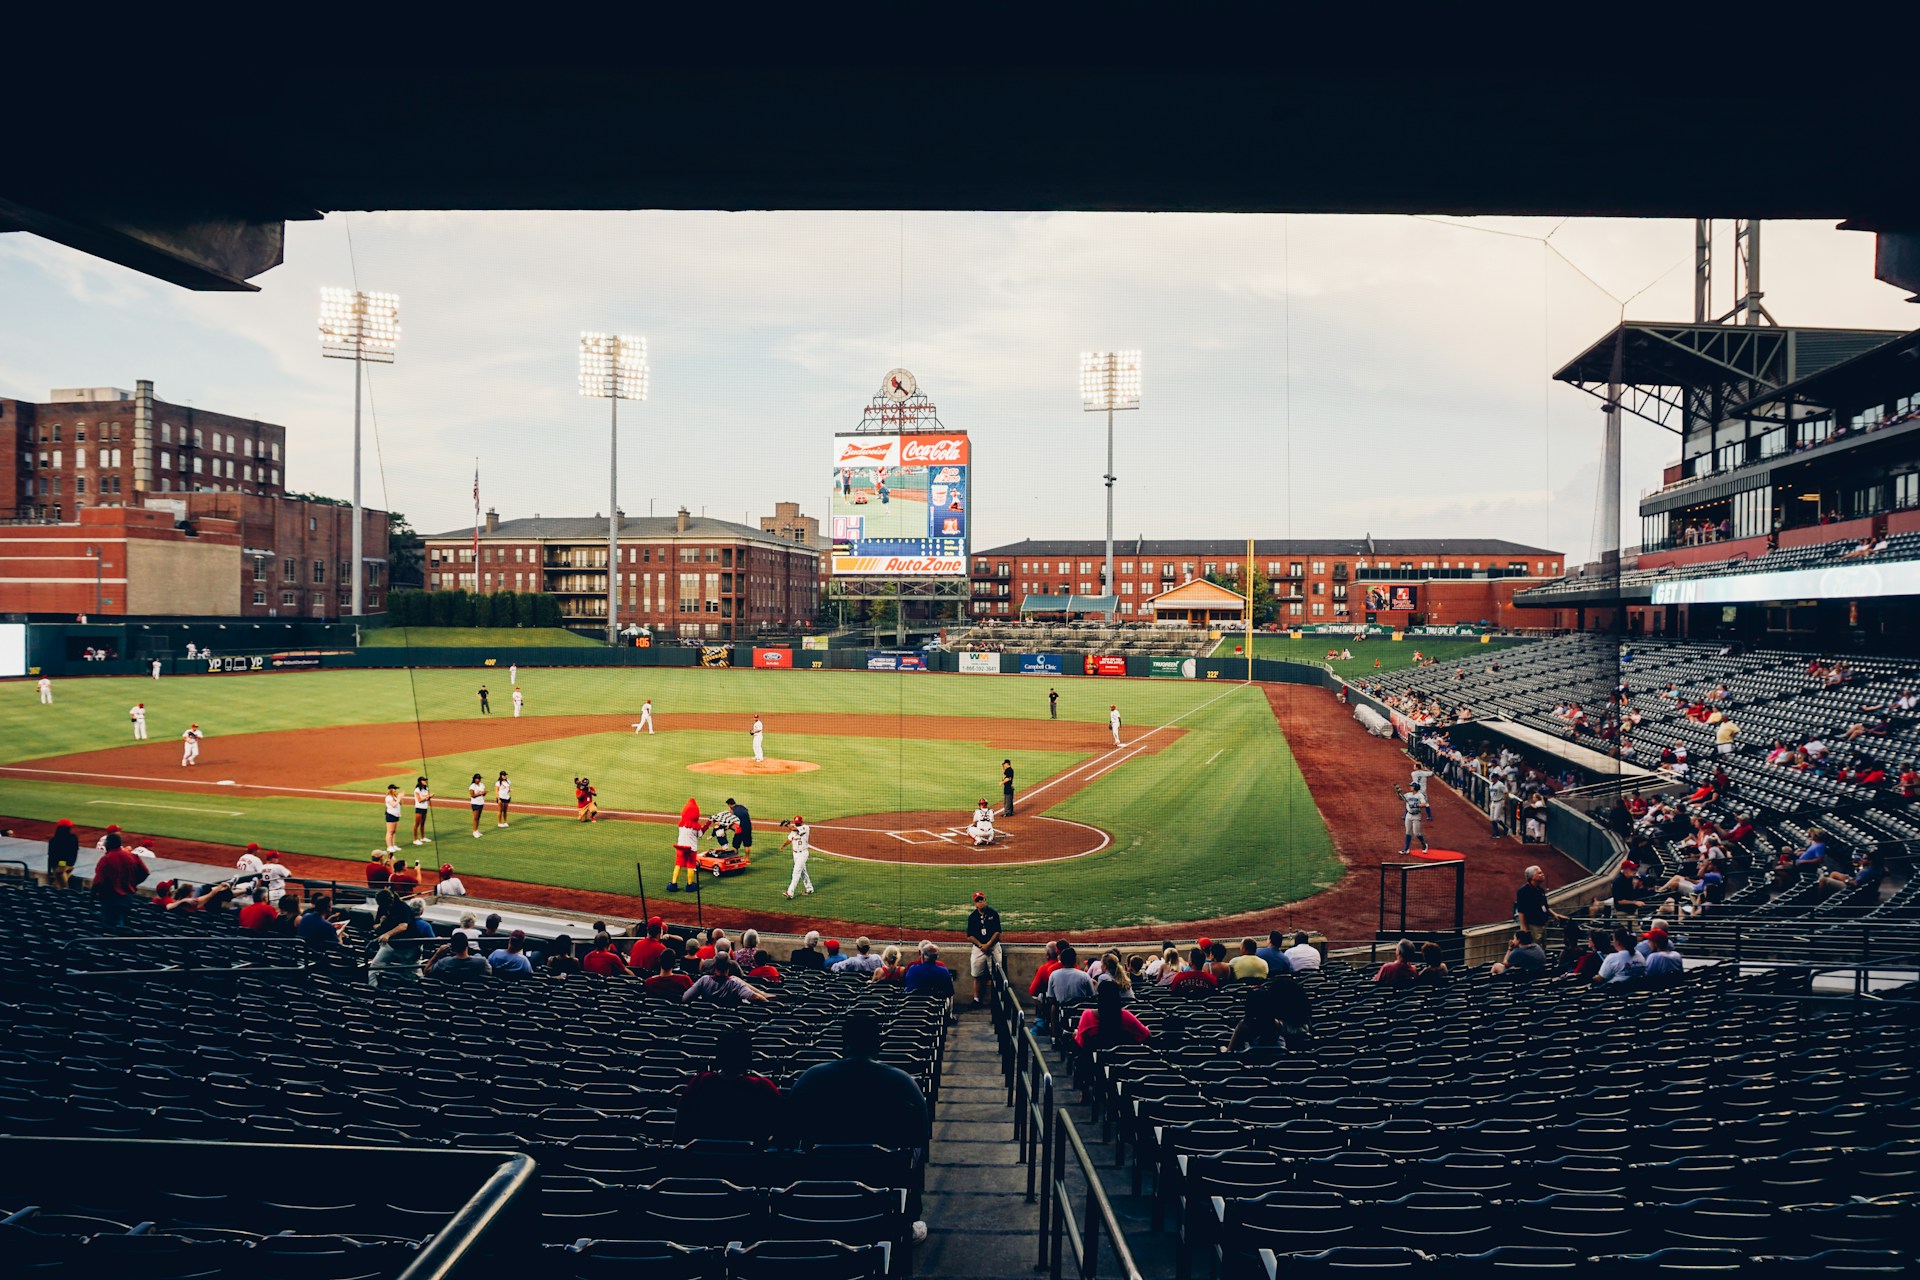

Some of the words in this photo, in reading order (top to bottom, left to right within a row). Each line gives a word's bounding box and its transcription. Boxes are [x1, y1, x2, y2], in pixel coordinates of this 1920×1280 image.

[864, 402, 936, 414] AUTOZONE
[882, 413, 917, 424] PARK
[841, 445, 892, 457] Budweiser
[902, 440, 963, 461] Coca-Cola
[885, 558, 962, 571] AutoZone
[1656, 585, 1678, 603] GET
[1680, 583, 1697, 603] IN
[208, 658, 222, 669] yp
[250, 656, 263, 667] yp
